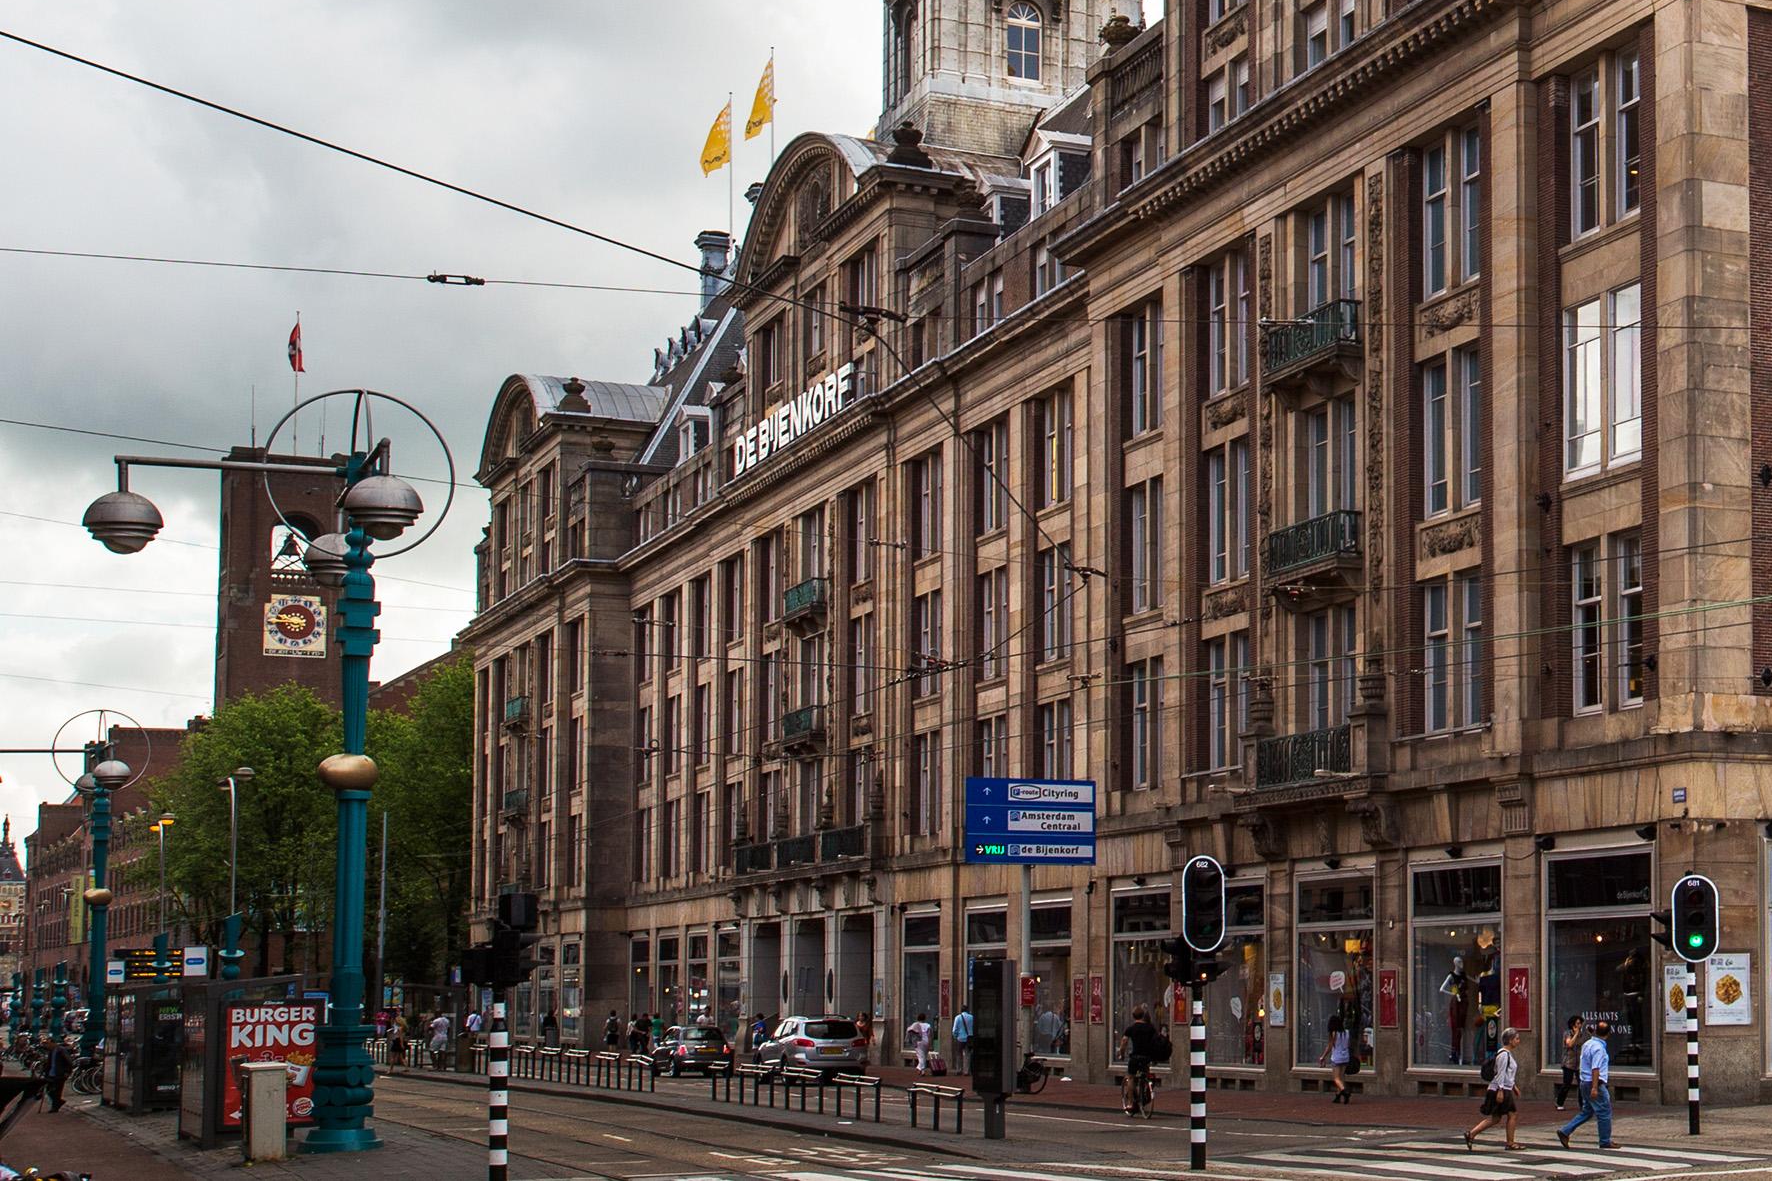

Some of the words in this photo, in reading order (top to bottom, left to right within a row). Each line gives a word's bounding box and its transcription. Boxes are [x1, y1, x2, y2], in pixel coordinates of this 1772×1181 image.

[735, 425, 757, 477] DE
[758, 361, 855, 460] BIJENKORF
[1042, 788, 1079, 800] Cityring
[1021, 811, 1075, 821] Amsterdam
[1040, 822, 1081, 831] Centraal
[984, 845, 1005, 855] VRIJ
[1021, 845, 1033, 854] de
[1035, 845, 1080, 856] Bijenkorf
[231, 1007, 316, 1024] BURGER
[1582, 1011, 1619, 1021] ALLSAINTS
[1617, 1025, 1633, 1034] ONE
[230, 1023, 316, 1049] KING
